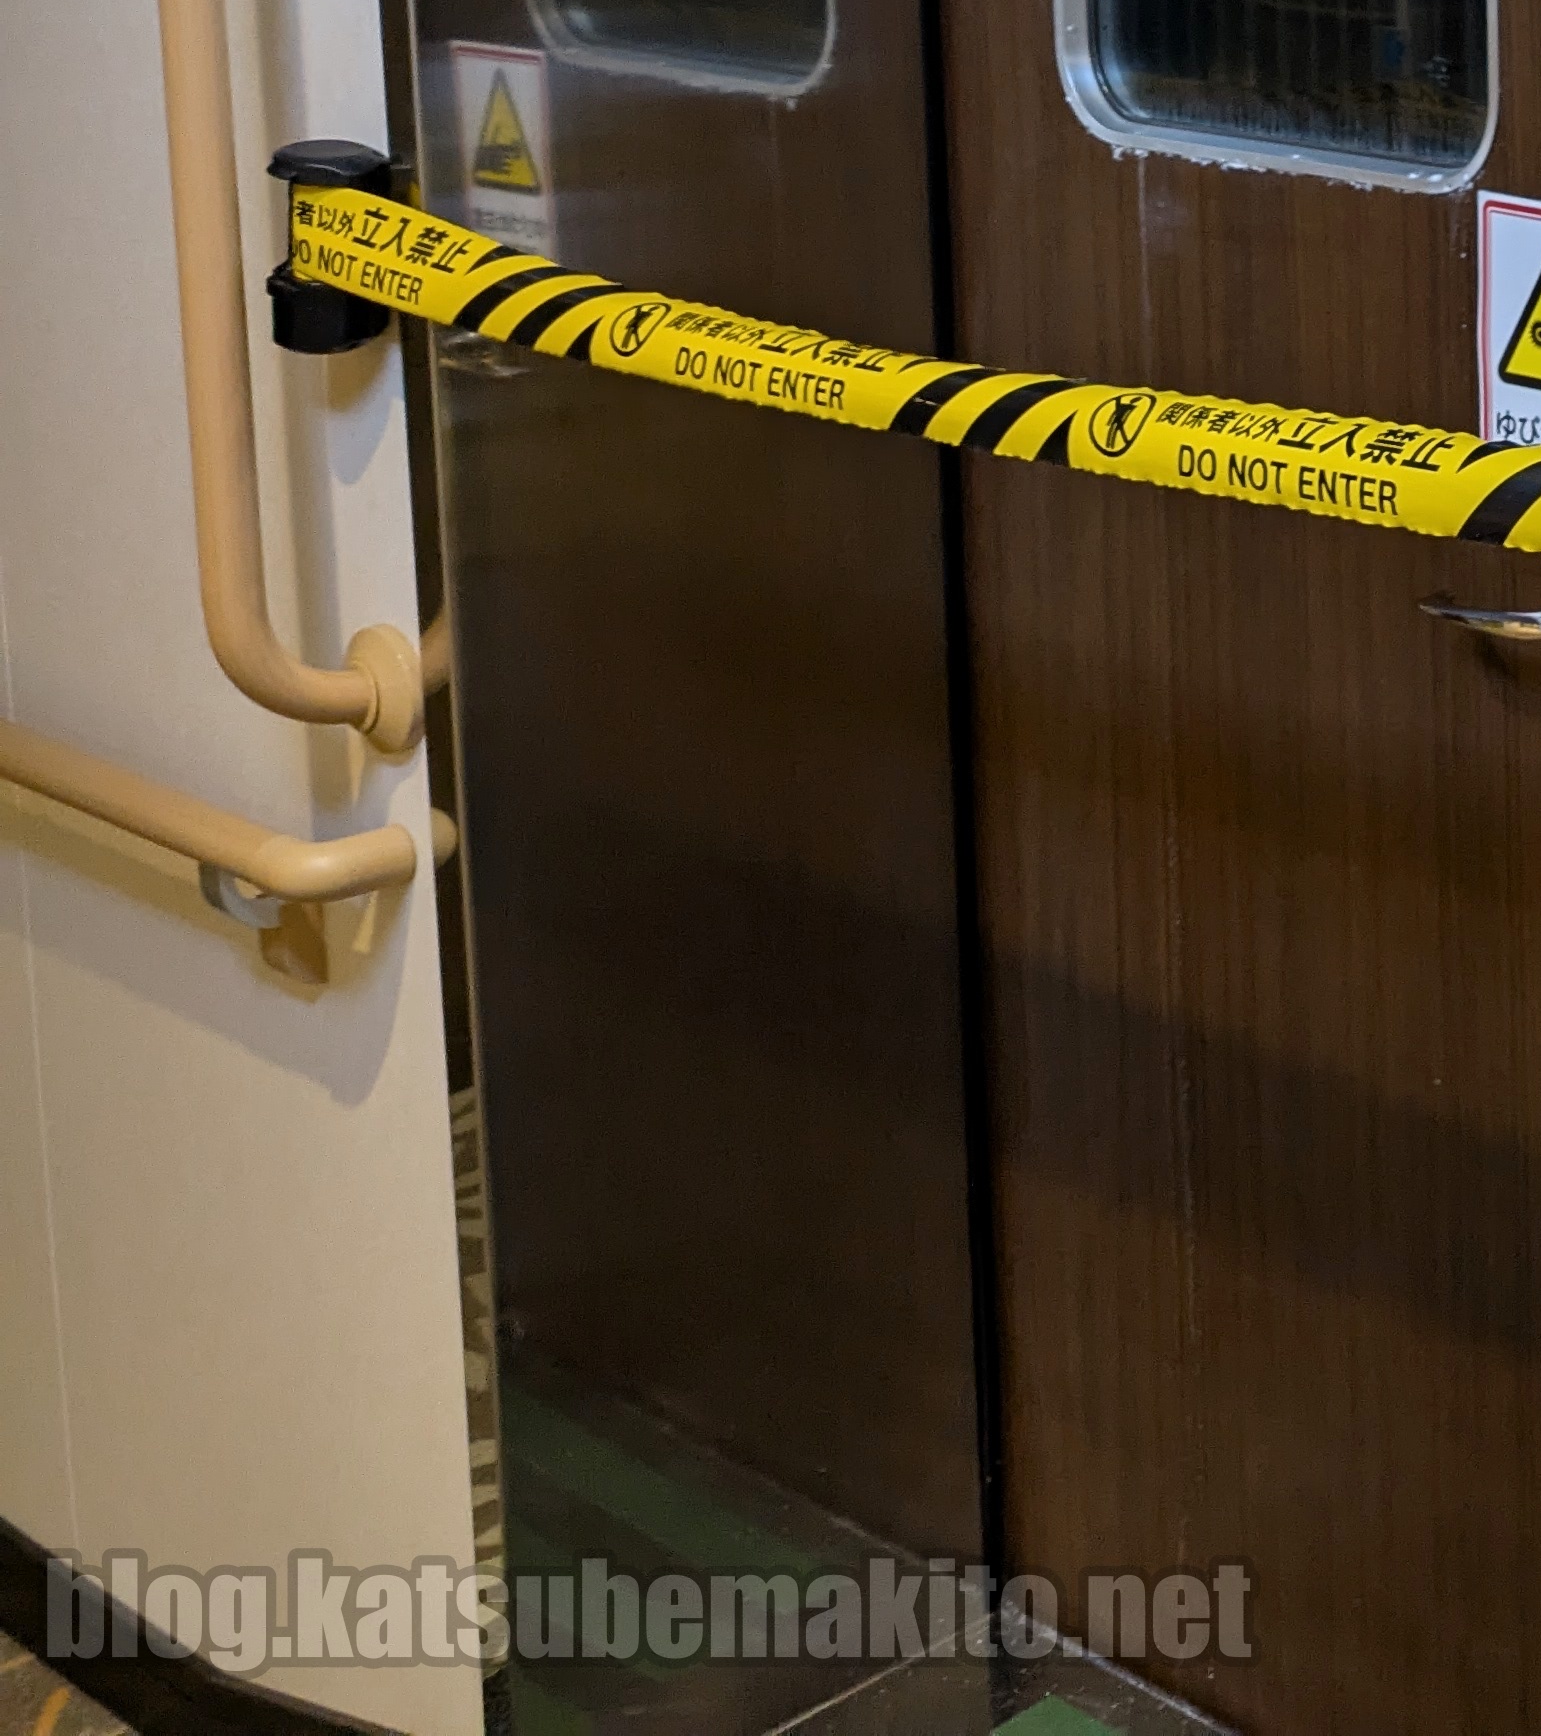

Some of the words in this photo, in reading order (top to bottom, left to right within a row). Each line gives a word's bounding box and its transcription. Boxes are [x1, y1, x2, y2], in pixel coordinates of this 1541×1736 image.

[318, 244, 357, 283] NOT
[360, 261, 424, 306] ENTER
[675, 346, 708, 380] DO
[713, 354, 763, 393] NOT
[767, 366, 846, 411] ENTER
[1178, 444, 1217, 482] DO
[1228, 452, 1288, 496] NOT
[1298, 465, 1399, 517] ENTER
